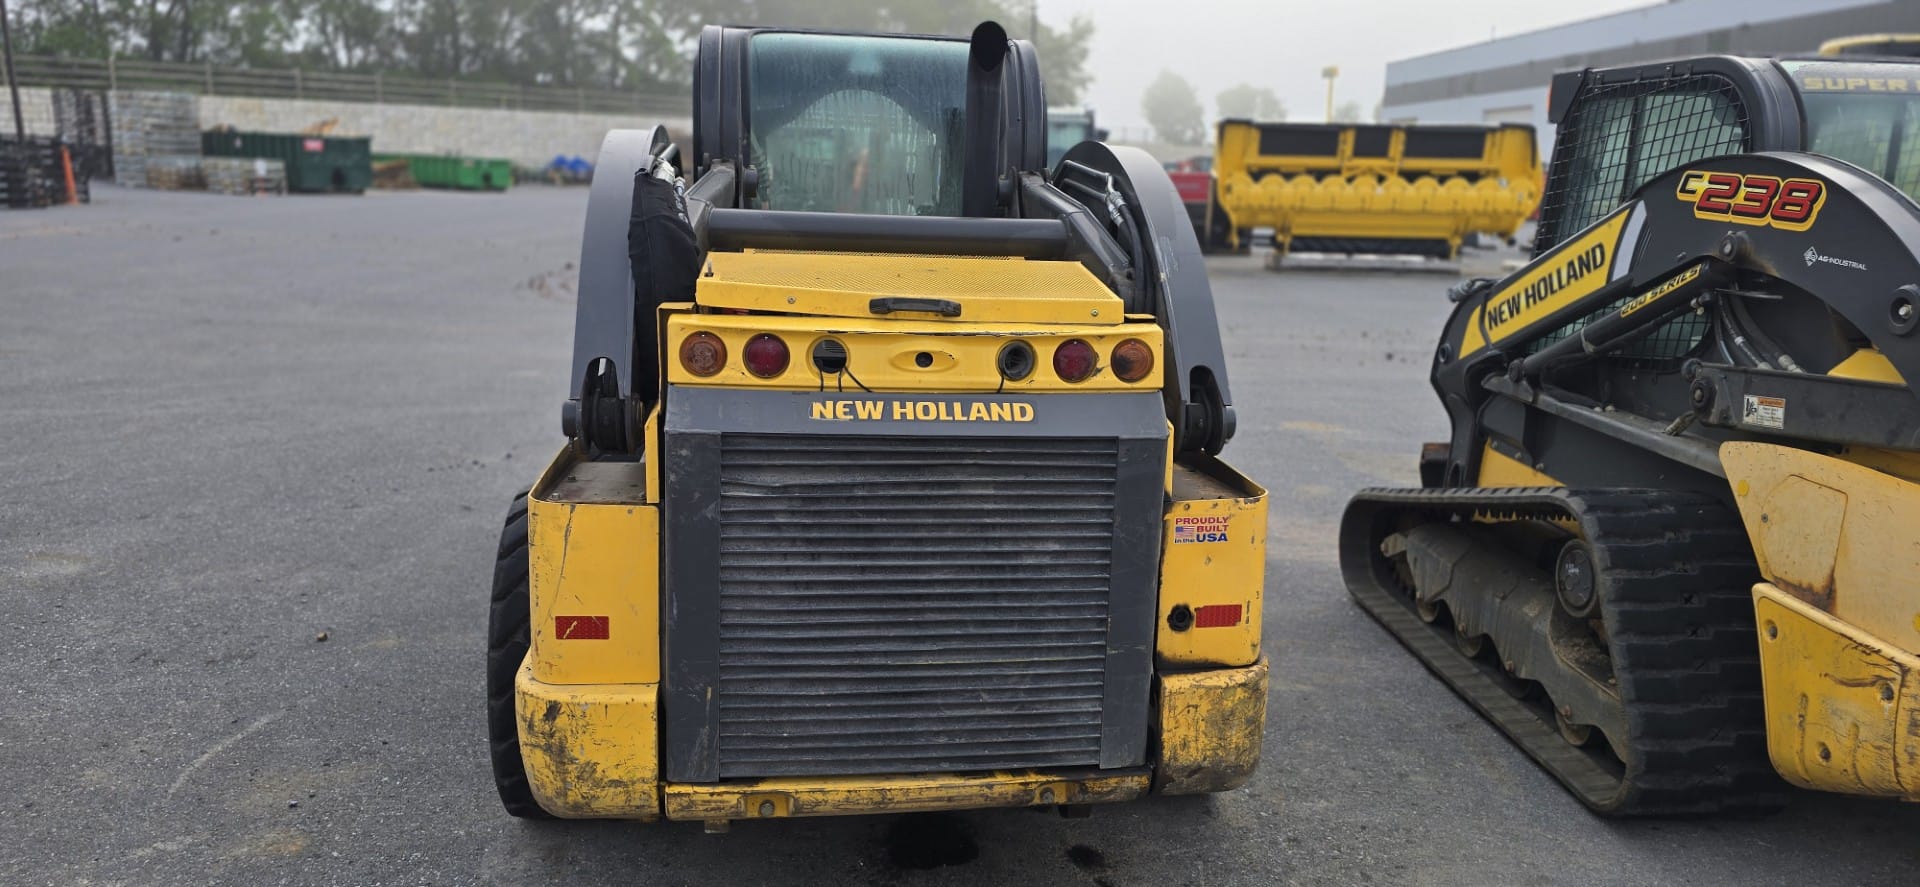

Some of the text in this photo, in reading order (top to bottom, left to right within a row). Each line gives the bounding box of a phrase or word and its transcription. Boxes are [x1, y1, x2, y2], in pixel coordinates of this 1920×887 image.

[1803, 77, 1908, 92] SUPER
[1677, 171, 1827, 231] C238
[1487, 242, 1606, 331] NEW HOLLAND
[1650, 267, 1700, 299] SERIES
[811, 400, 1034, 422] NEW HOLLAND
[1175, 516, 1229, 525] PROUDLY
[1196, 533, 1228, 543] USA
